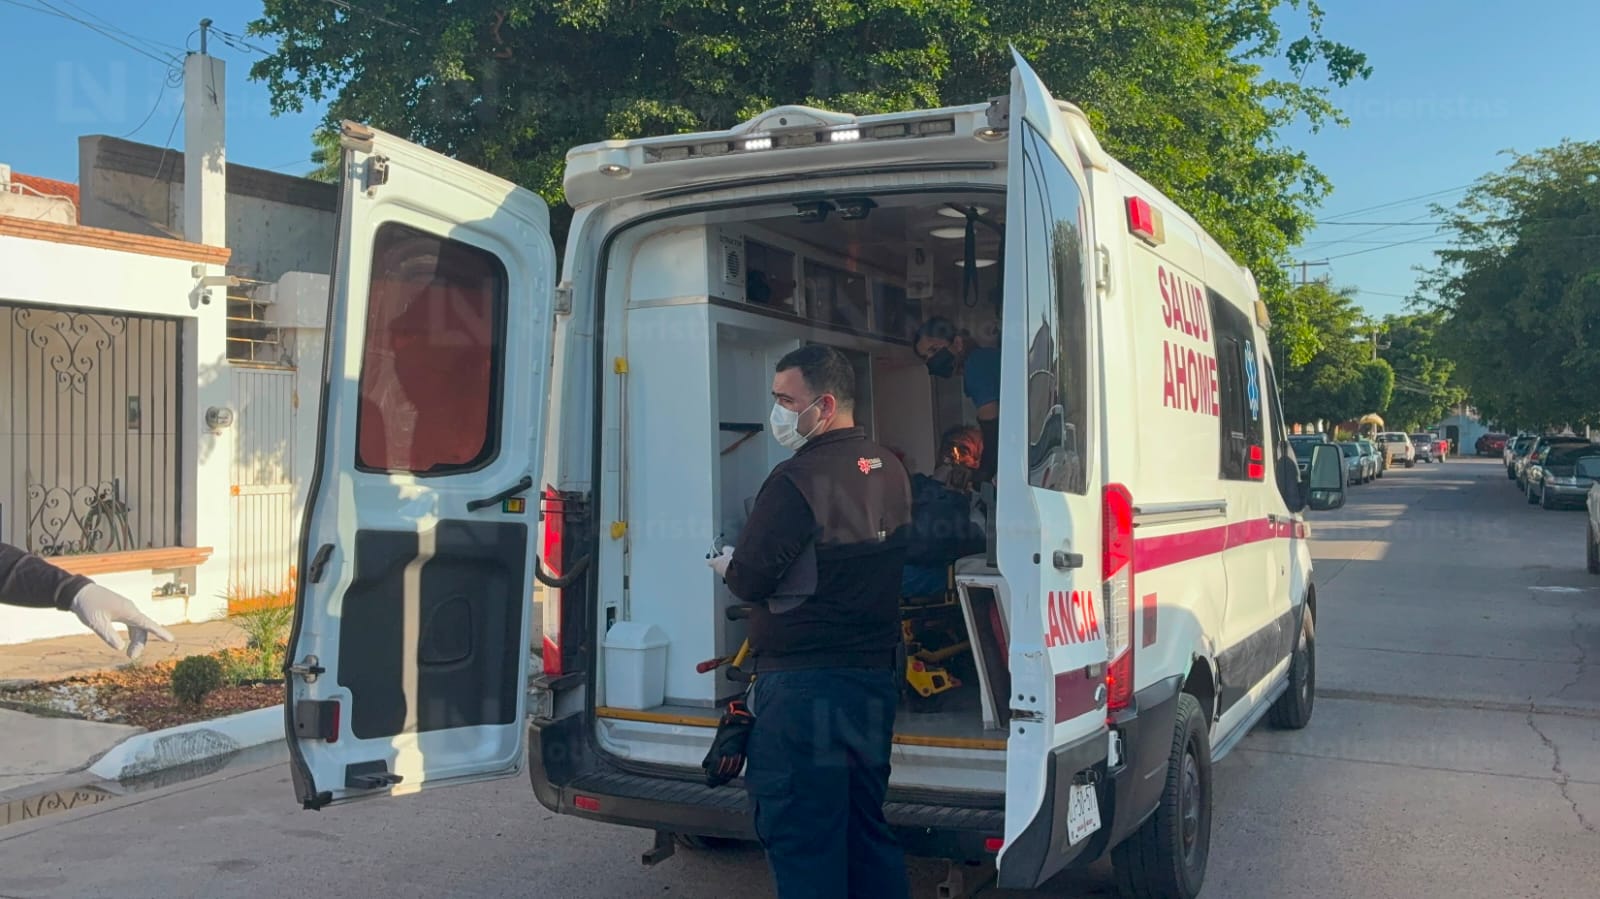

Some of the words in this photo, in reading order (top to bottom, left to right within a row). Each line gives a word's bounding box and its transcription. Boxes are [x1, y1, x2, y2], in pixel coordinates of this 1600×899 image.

[1158, 265, 1208, 342] SALUD
[1163, 340, 1219, 417] AHOME
[1045, 590, 1101, 647] ANCIA
